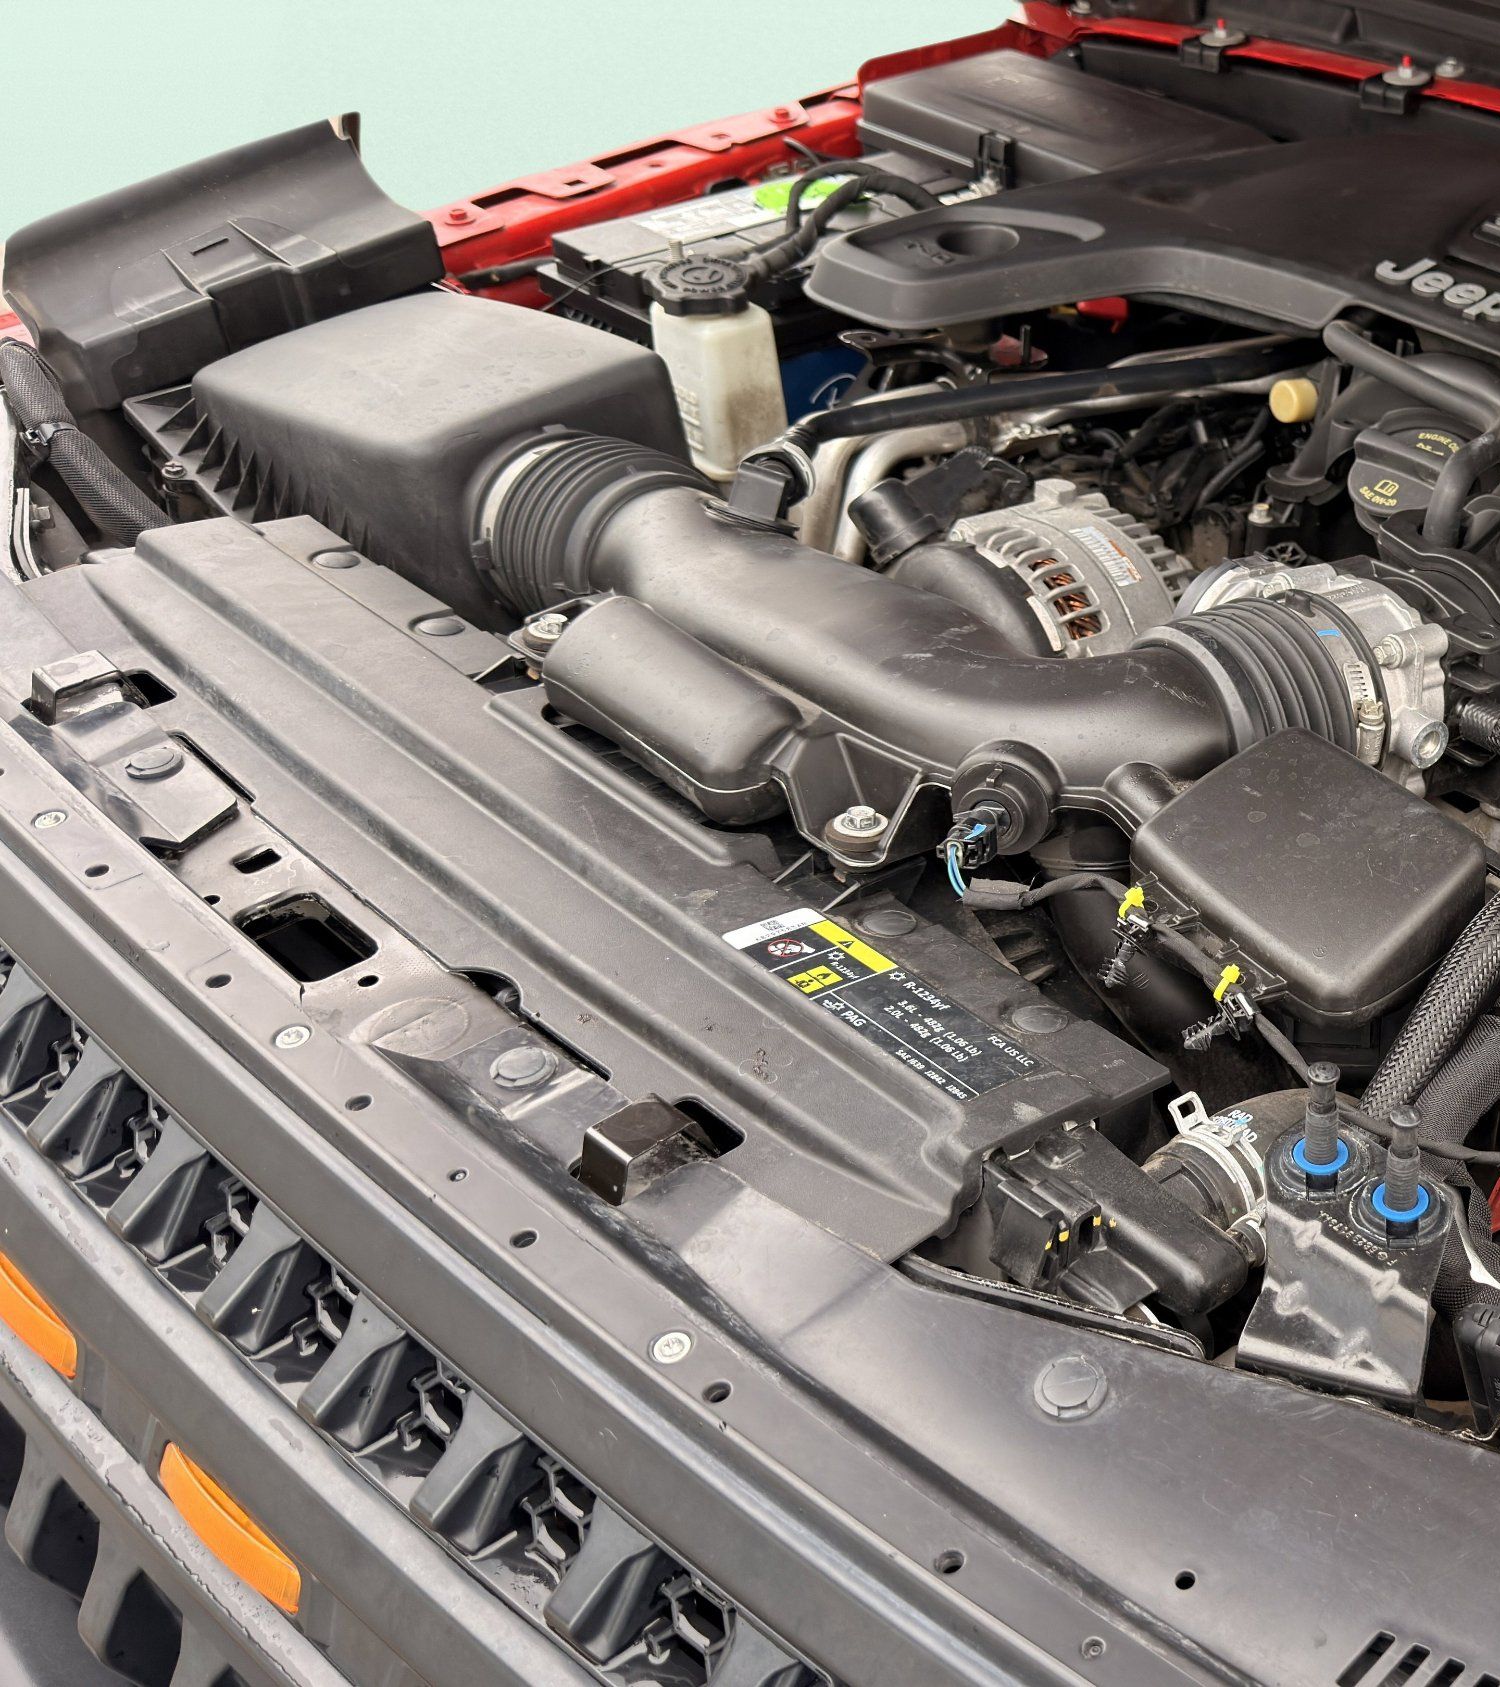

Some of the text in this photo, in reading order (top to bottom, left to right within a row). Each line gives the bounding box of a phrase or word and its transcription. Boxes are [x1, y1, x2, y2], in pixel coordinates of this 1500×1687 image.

[1418, 432, 1451, 446] ENGINE
[1359, 486, 1374, 500] SAE
[902, 981, 952, 1011] R-1234yf
[840, 1007, 867, 1027] PAG
[884, 1005, 905, 1020] 2.0L
[929, 1037, 953, 1053] (1.06
[951, 1050, 969, 1063] Lb)
[897, 999, 918, 1014] 3.6L
[942, 1031, 966, 1048] (1.06
[964, 1044, 982, 1058] Lb)
[895, 1049, 909, 1061] SAE
[987, 1035, 1035, 1067] FCA US LLC
[1228, 1109, 1253, 1123] RAD
